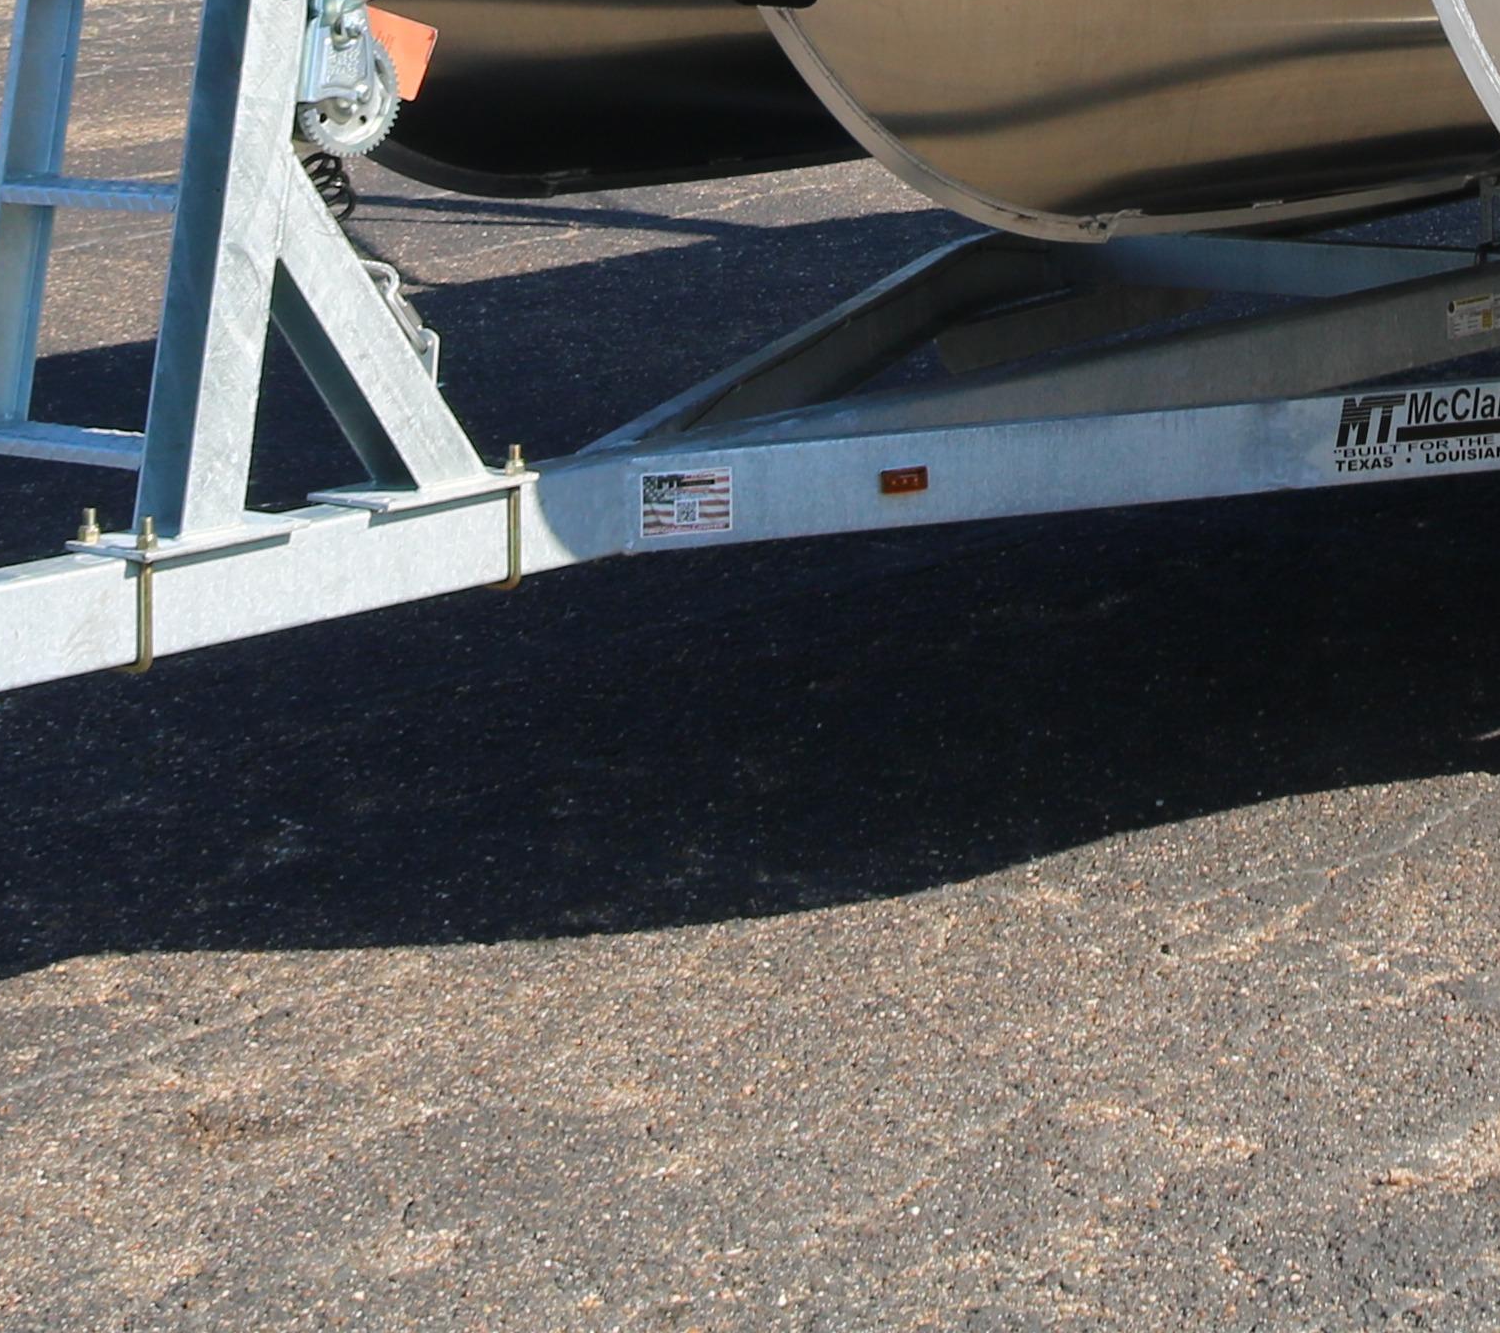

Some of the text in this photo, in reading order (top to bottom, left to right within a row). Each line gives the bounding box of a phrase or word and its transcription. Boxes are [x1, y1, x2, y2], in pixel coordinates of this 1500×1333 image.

[1335, 393, 1407, 448] MT
[1407, 439, 1450, 452] FOR
[1458, 434, 1495, 447] THE
[1335, 456, 1394, 473] TEXAS
